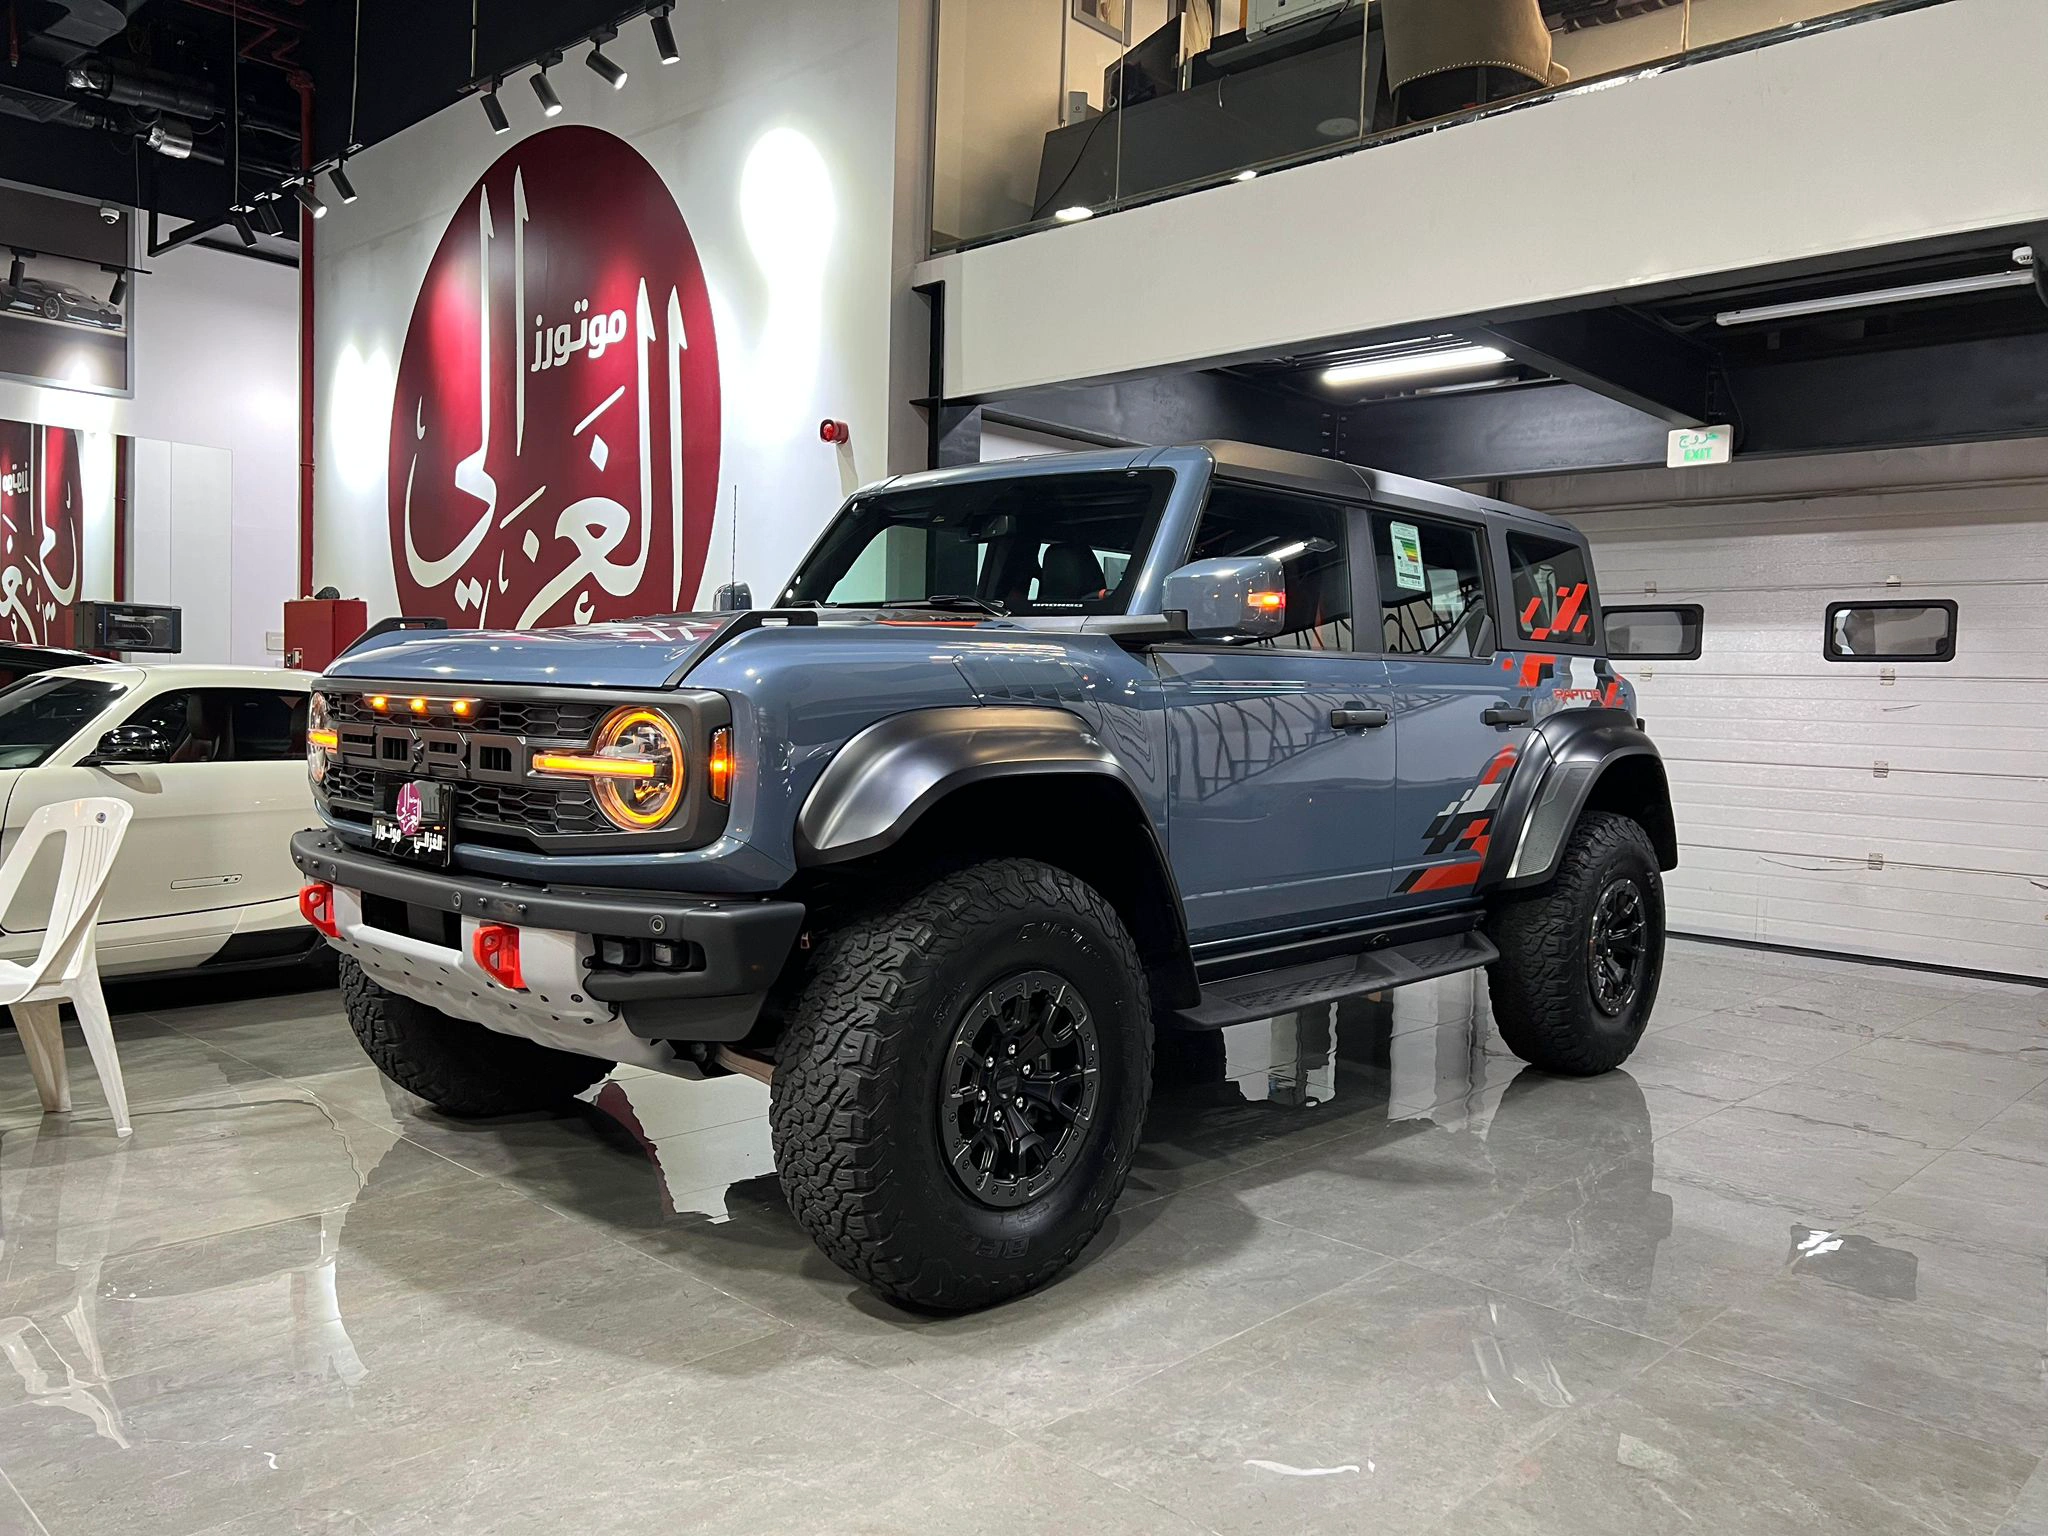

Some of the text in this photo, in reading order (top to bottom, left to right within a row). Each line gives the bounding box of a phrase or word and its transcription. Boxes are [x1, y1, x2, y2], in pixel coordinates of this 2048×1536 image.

[530, 298, 627, 372] موتورز
[1684, 447, 1713, 462] EXIT
[1553, 688, 1601, 704] RAPTOR
[337, 722, 525, 784] FORD
[375, 820, 443, 854] الغزالي موتورز
